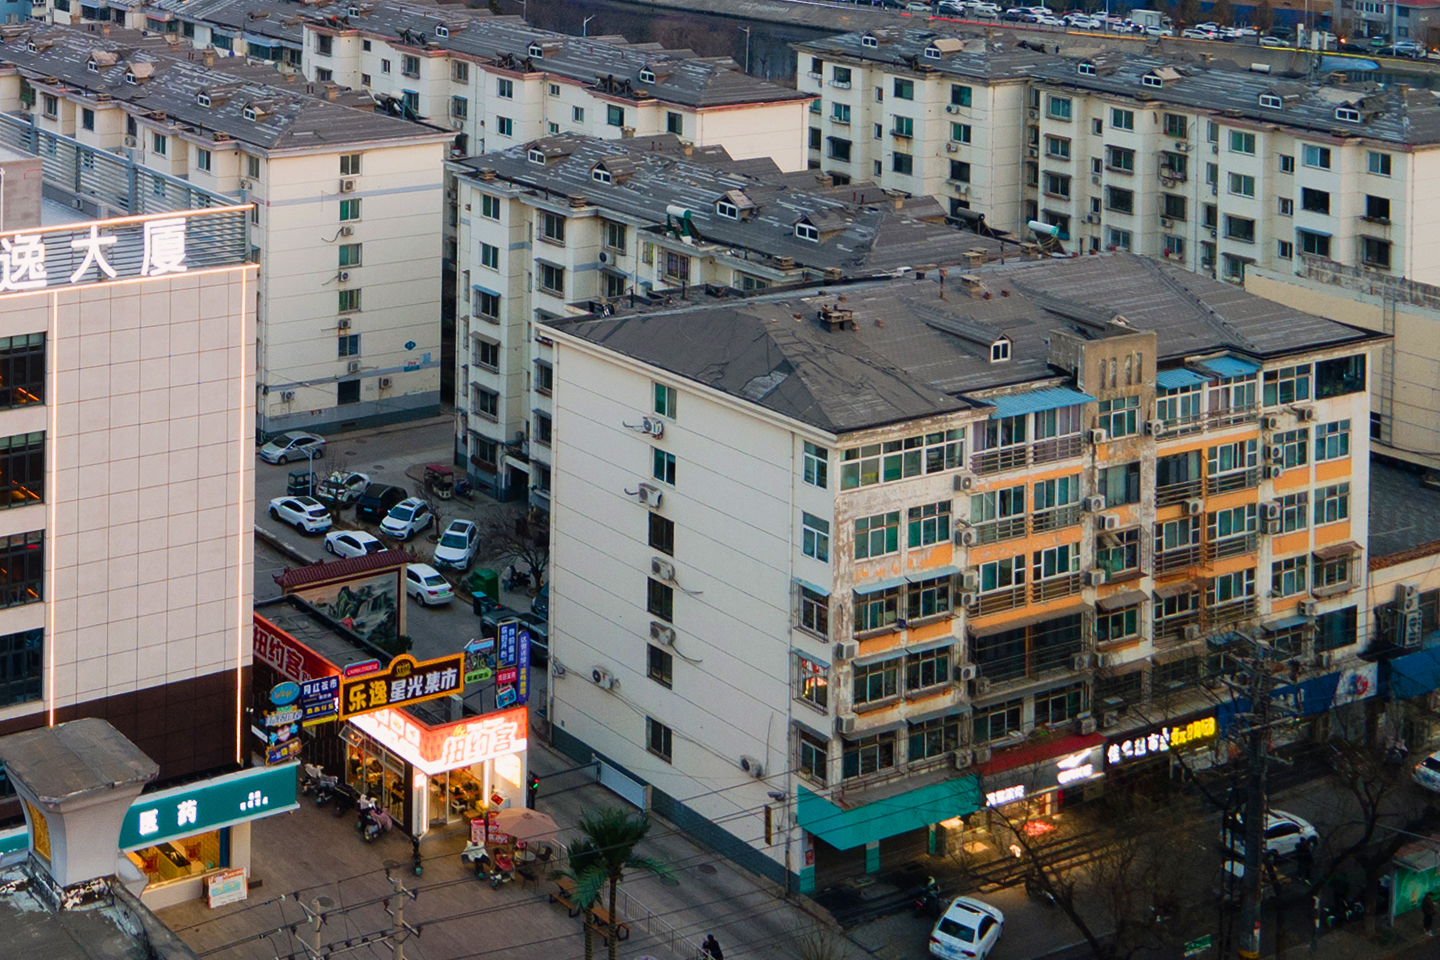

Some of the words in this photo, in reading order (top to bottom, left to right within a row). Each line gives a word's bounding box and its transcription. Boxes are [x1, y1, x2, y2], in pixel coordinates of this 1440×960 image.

[348, 667, 458, 713] 乐逸星光集市
